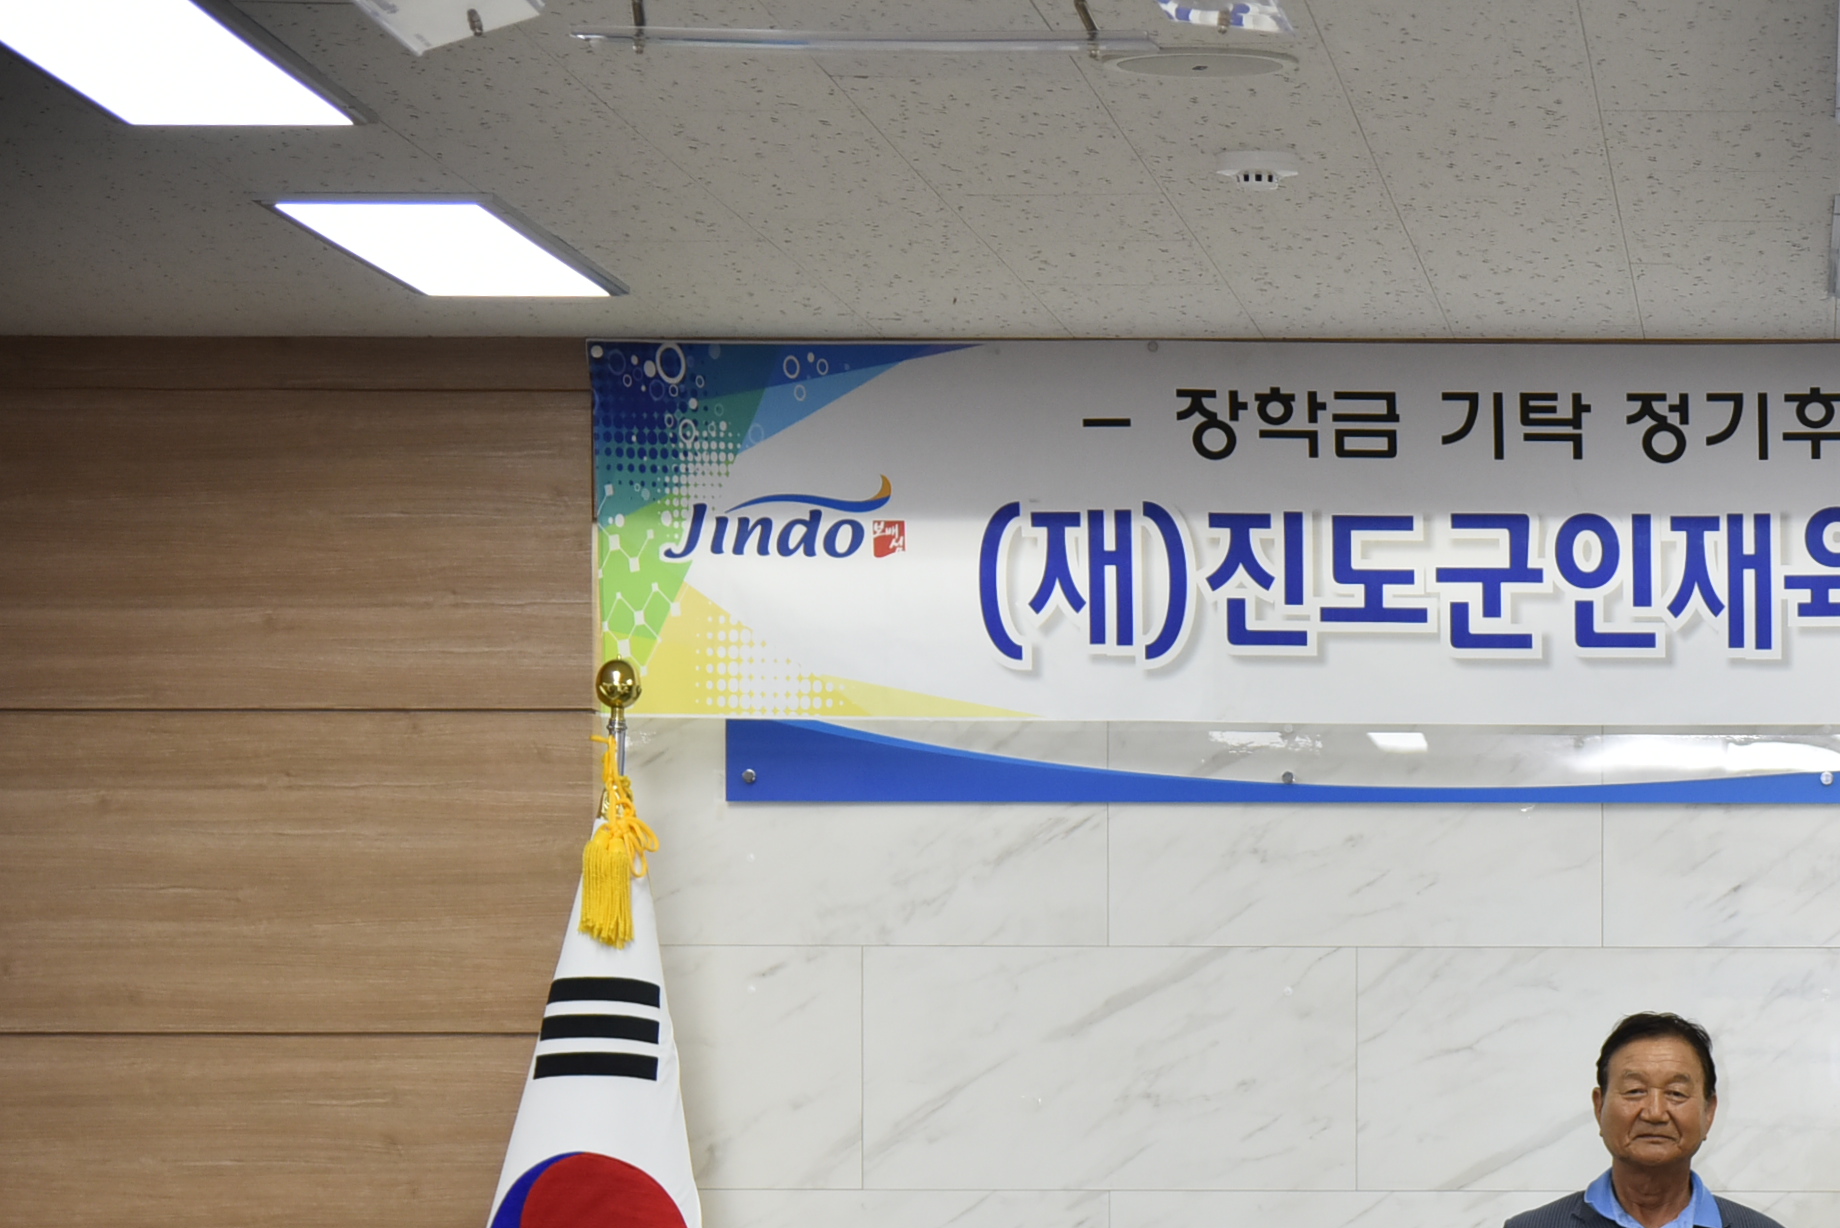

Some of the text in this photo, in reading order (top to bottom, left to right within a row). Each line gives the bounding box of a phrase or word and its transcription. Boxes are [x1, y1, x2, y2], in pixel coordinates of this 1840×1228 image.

[1176, 386, 1400, 461] 장학금
[1441, 392, 1592, 460] 기탁
[664, 502, 866, 560] Jindo
